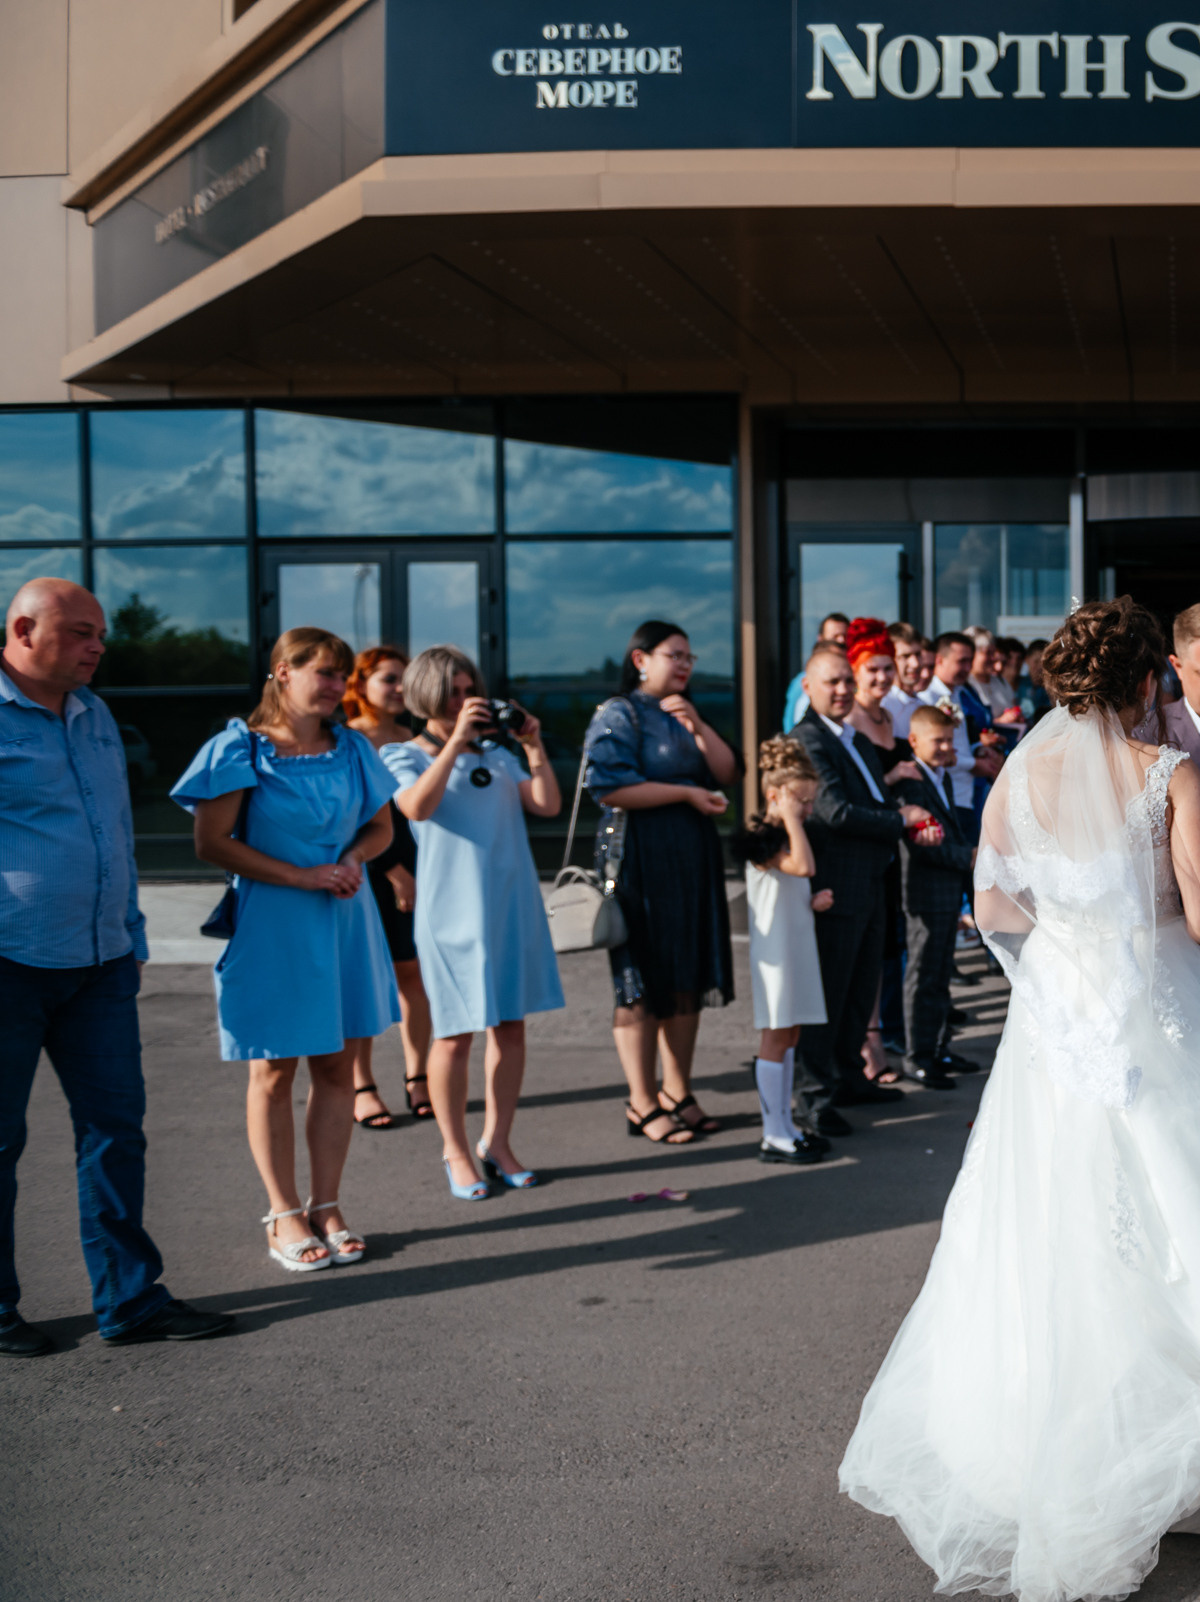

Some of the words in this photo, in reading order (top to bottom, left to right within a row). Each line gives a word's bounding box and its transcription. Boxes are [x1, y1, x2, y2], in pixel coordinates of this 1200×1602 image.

[542, 22, 629, 41] ОТЕЛЬ
[491, 46, 683, 77] СЕВЕРНОЕ
[805, 22, 1131, 101] NORTH
[535, 80, 639, 109] МОРЕ
